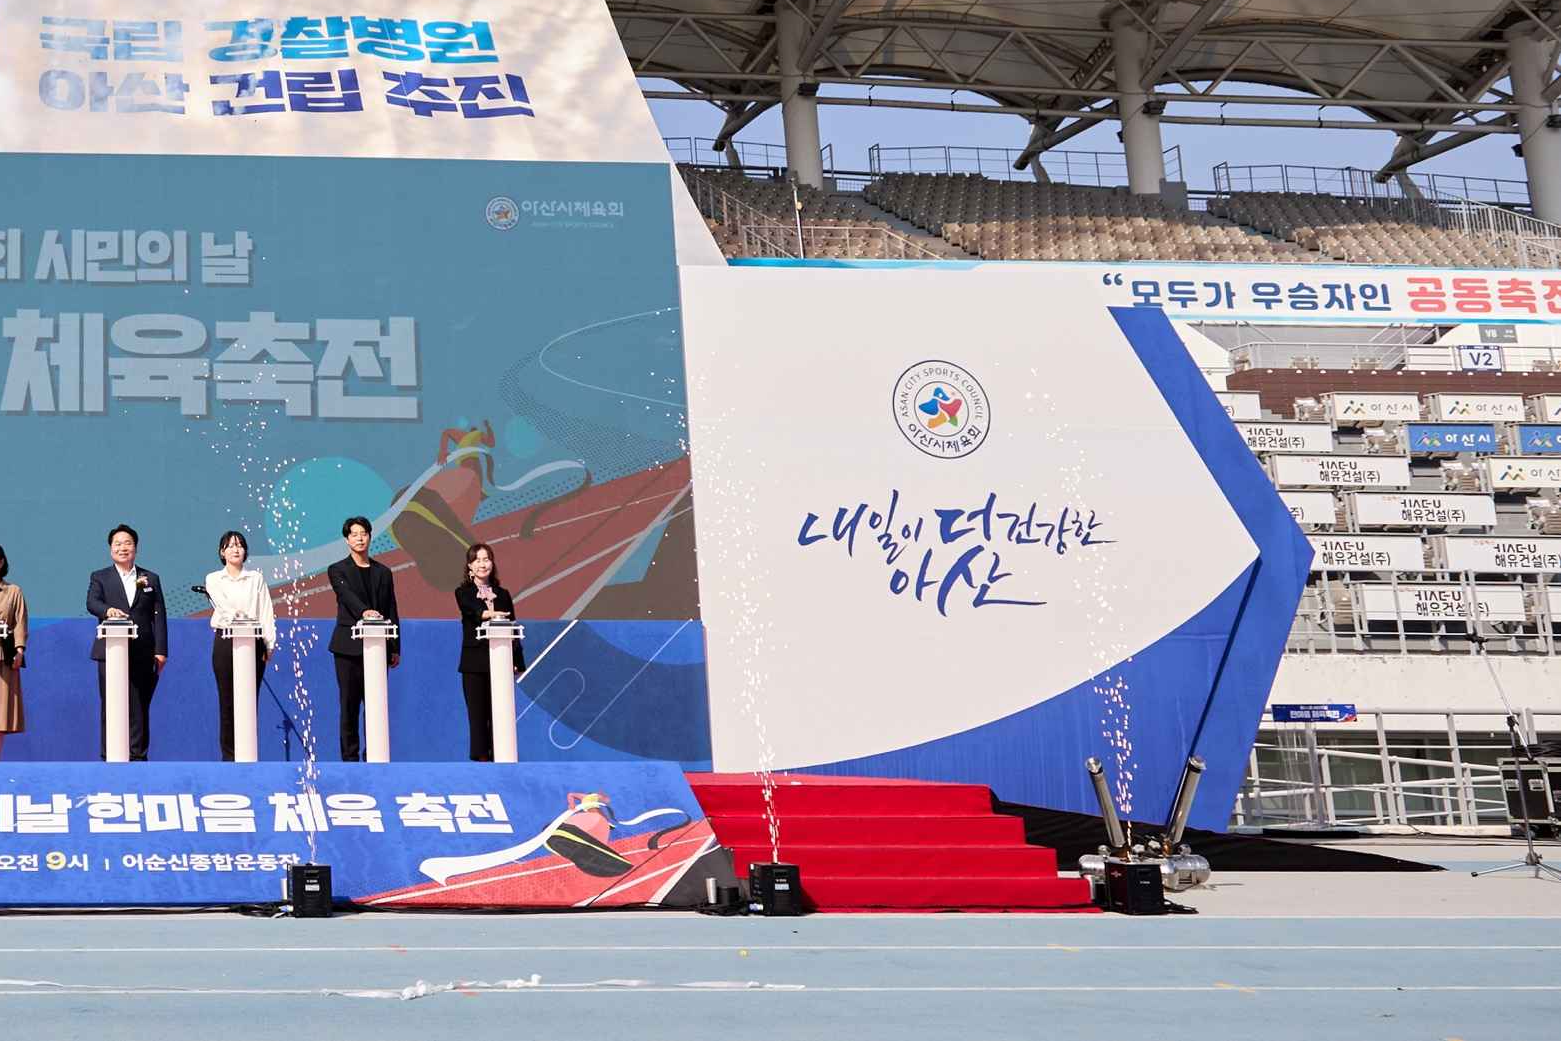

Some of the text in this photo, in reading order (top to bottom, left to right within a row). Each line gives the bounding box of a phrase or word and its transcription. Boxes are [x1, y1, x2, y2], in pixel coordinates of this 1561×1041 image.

[40, 16, 499, 63] 국립 경찰병원
[39, 69, 536, 119] 아산 건립 추진
[521, 200, 624, 217] 아산시체육회
[35, 229, 188, 283] 시민의
[200, 231, 254, 284] 날
[1251, 282, 1392, 311] 우승자인
[0, 308, 419, 420] 체육축전
[1469, 352, 1494, 366] V2
[923, 367, 961, 381] SPORTS
[961, 379, 984, 420] COUNCIL
[1370, 403, 1417, 416] 아산시
[1475, 404, 1518, 416] 아산시
[908, 423, 983, 453] 아산시체육회
[1444, 433, 1491, 447] 아산시
[1319, 470, 1381, 483] 해유건설(주)
[797, 489, 1119, 565] 내일이 더 건강한
[1401, 509, 1466, 523] 해유건설(주)
[1321, 551, 1391, 566] 해유건설(주)
[889, 545, 1047, 617] 아산
[86, 793, 257, 833] 한마음
[268, 793, 383, 833] 체육
[394, 793, 514, 833] 축전
[46, 851, 89, 872] 9시
